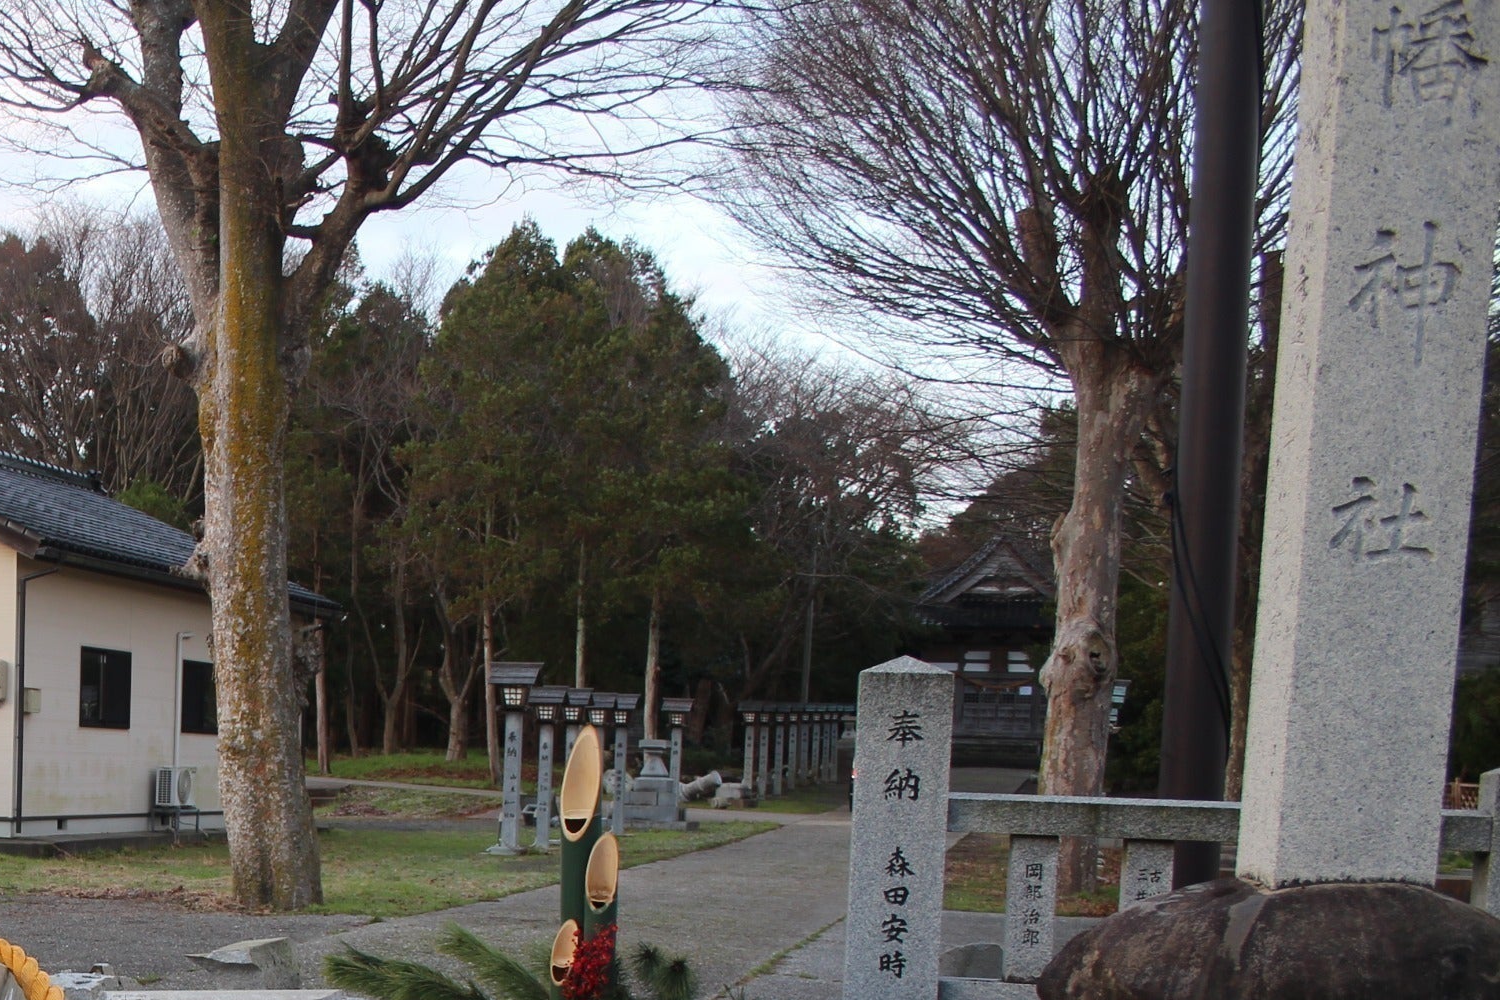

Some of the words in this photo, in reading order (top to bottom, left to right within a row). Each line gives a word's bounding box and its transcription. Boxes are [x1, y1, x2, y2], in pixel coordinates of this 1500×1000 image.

[885, 710, 924, 801] 奉納
[879, 847, 916, 979] 森田安時
[1022, 862, 1043, 948] 岡部治郎
